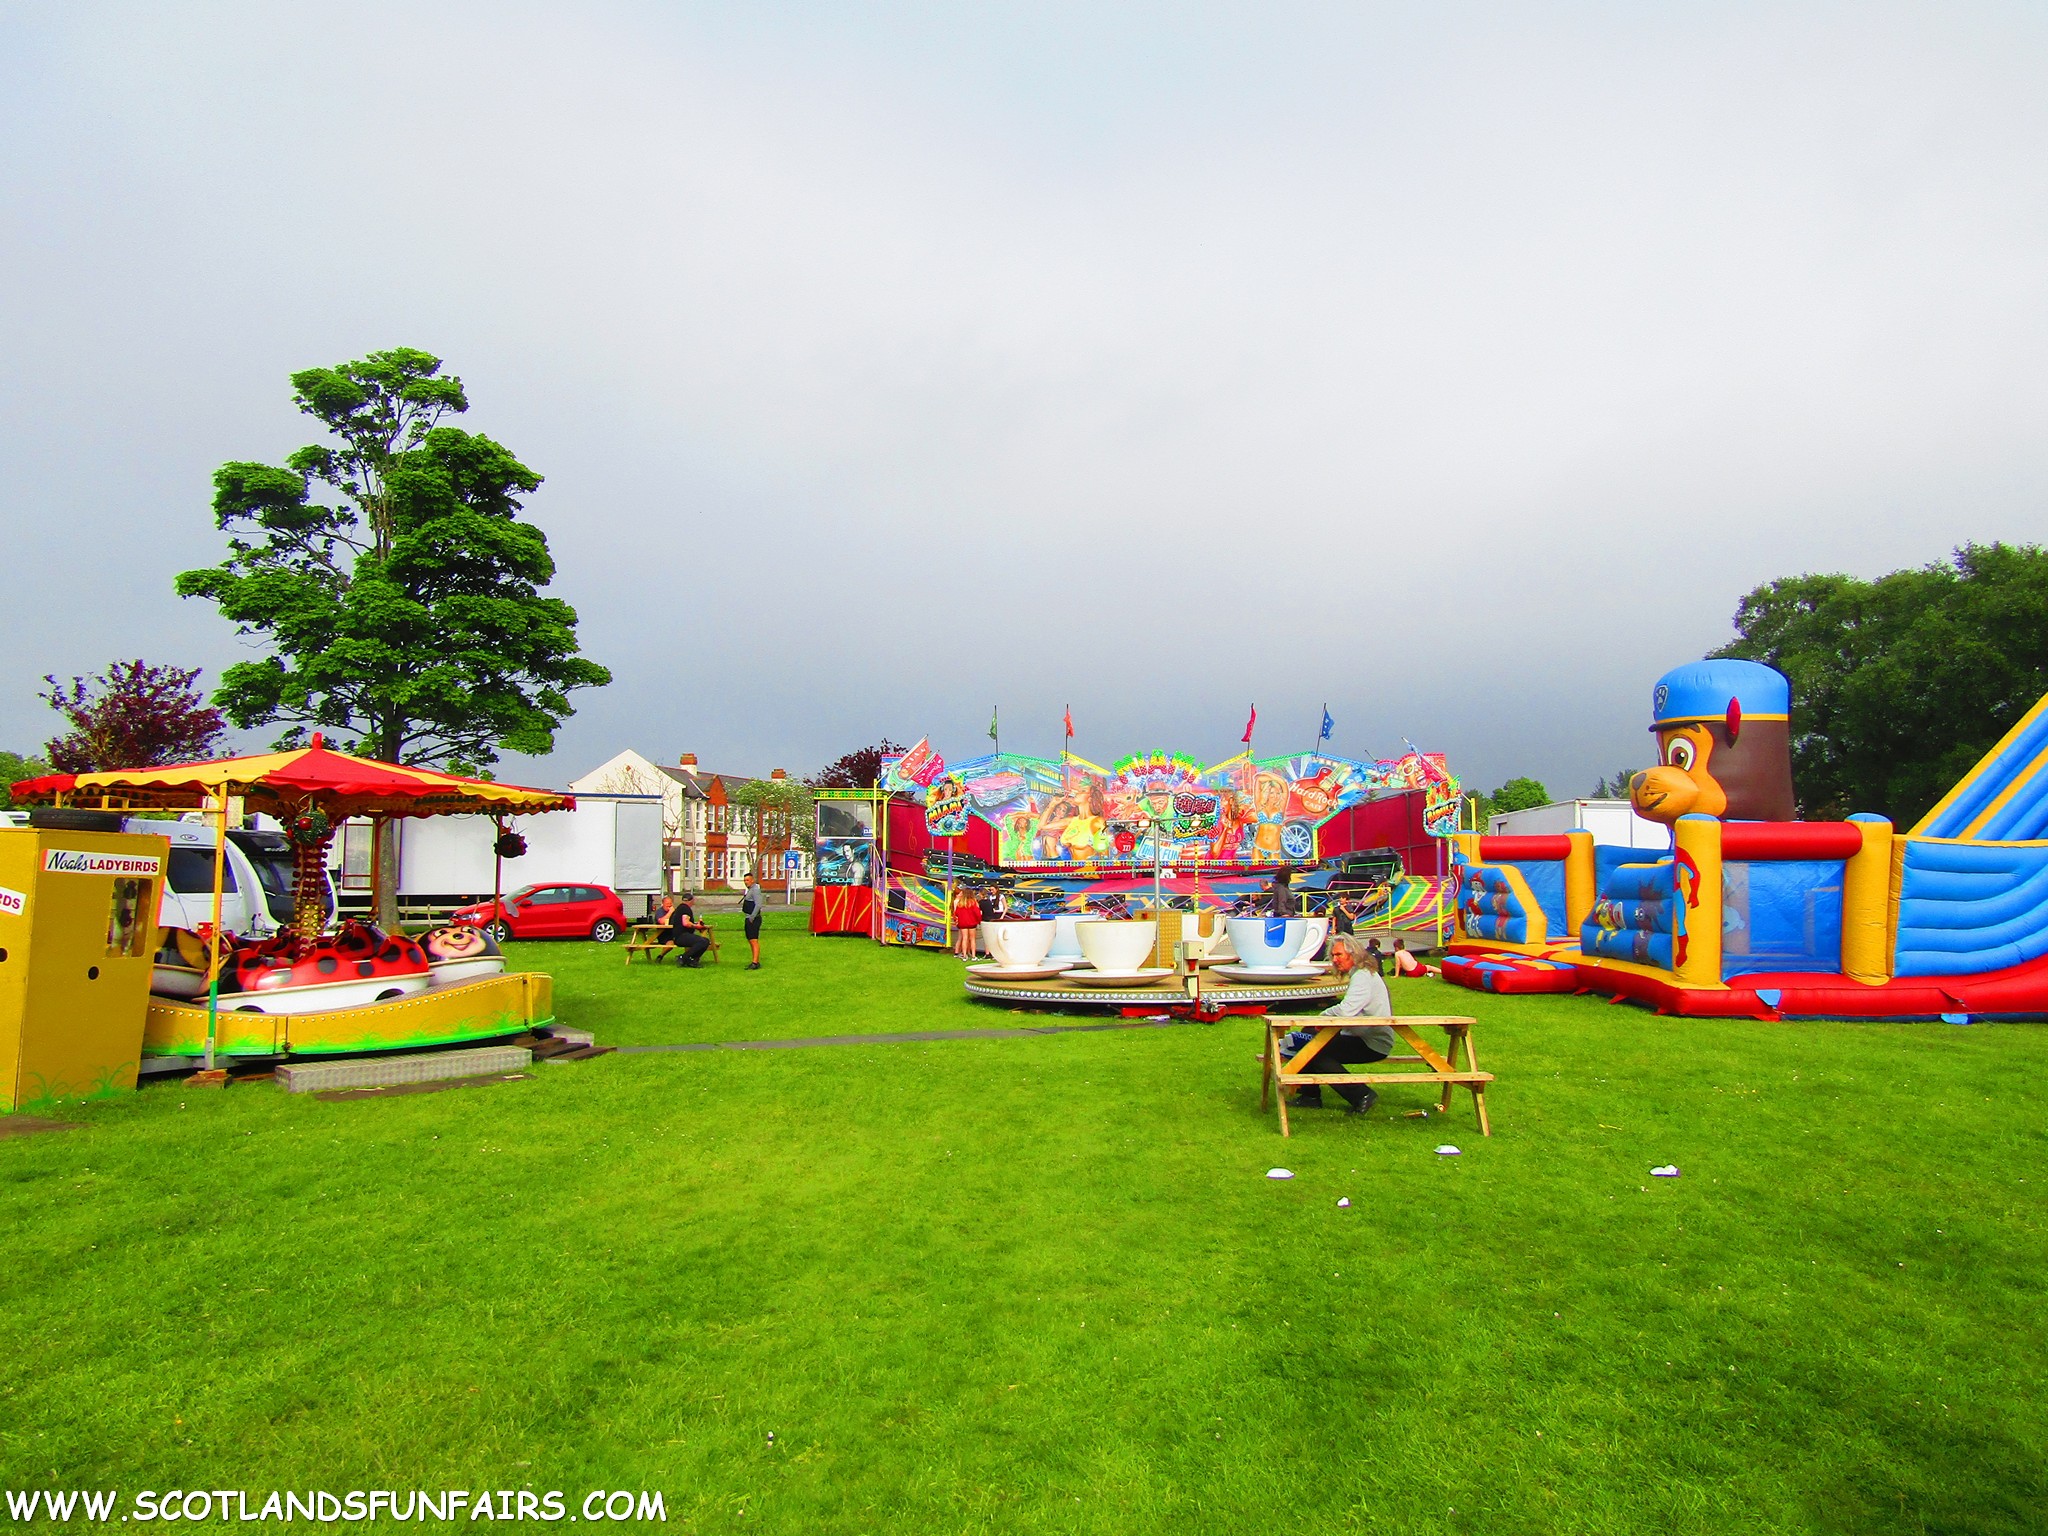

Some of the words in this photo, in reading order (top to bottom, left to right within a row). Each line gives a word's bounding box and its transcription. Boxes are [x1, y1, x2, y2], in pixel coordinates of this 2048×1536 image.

[1289, 782, 1317, 799] Hard
[1315, 791, 1338, 809] Rock
[928, 801, 963, 824] MIAMI
[1162, 848, 1180, 860] FUN
[89, 858, 159, 873] LADYBIRDS
